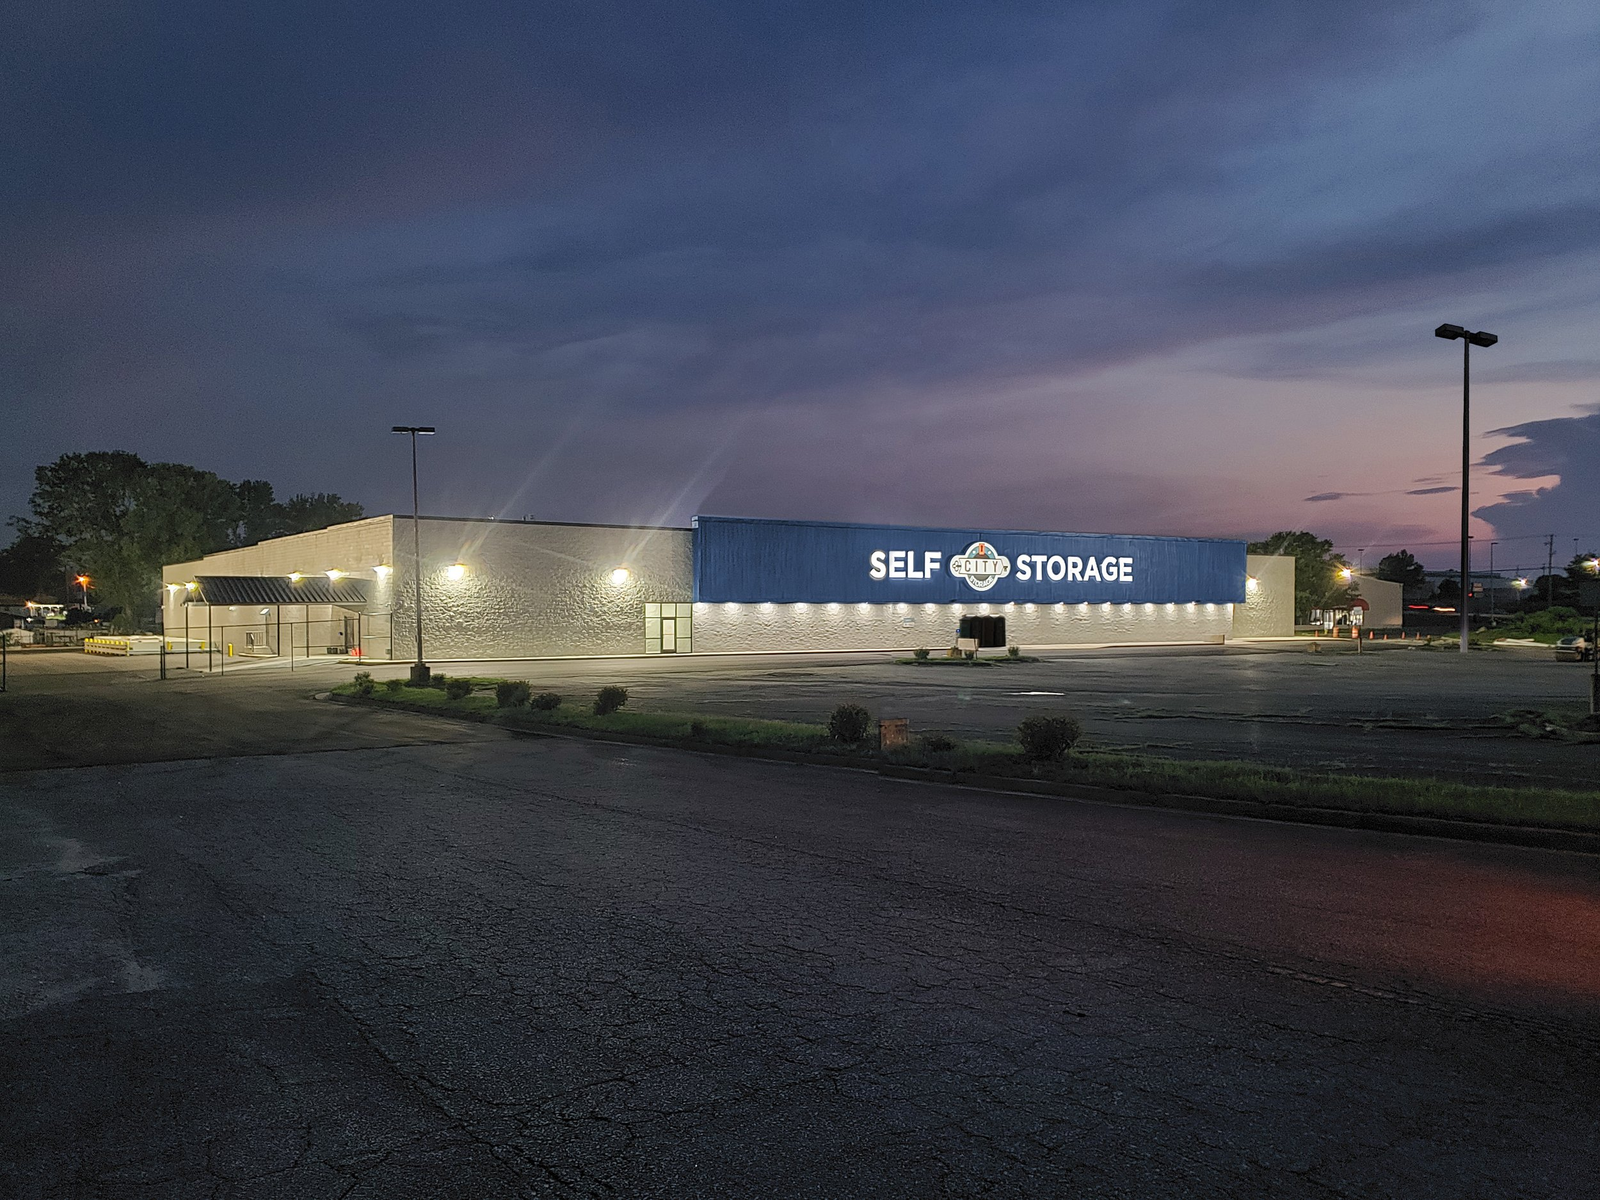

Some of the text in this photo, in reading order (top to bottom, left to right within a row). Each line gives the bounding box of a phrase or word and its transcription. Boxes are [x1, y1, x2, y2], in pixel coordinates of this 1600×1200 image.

[869, 550, 1133, 582] SELF CITY STORAGE
[969, 575, 995, 588] STORAGE
